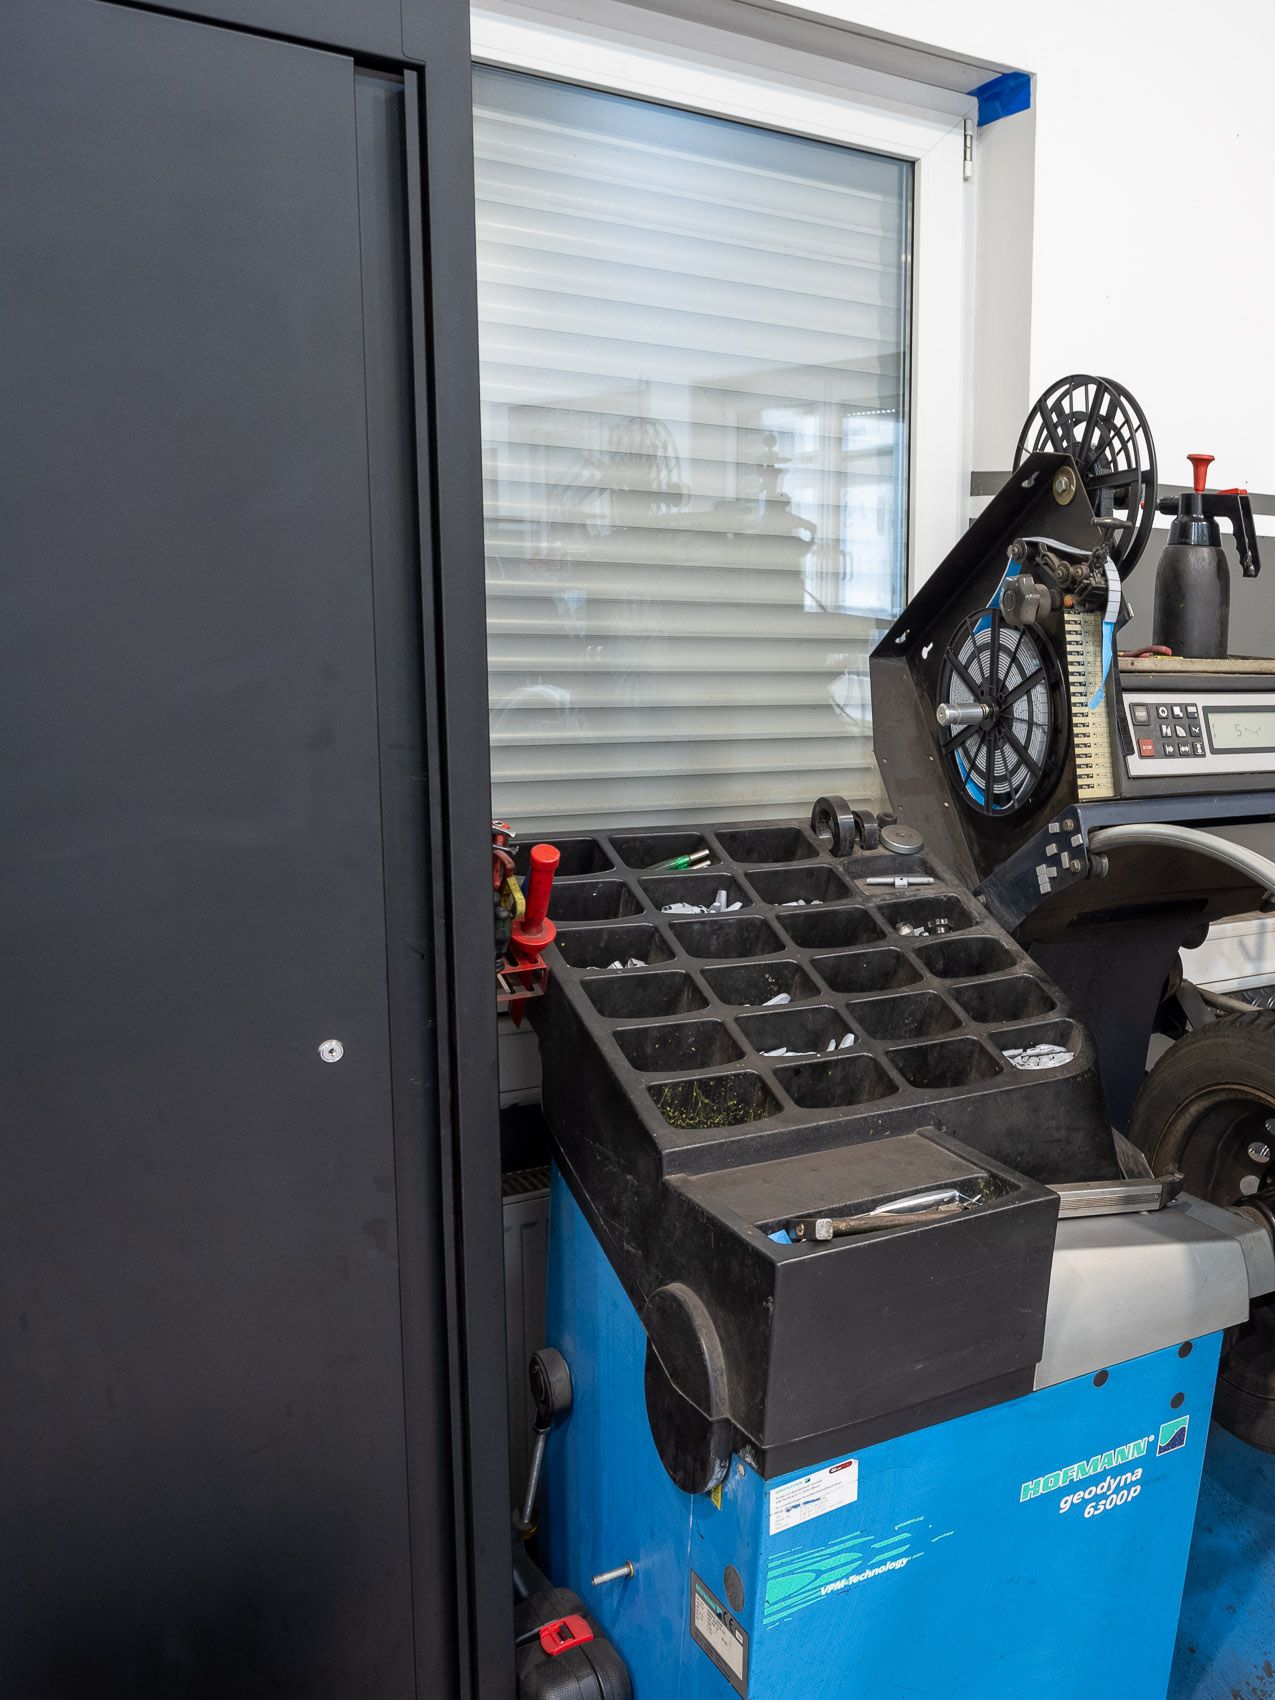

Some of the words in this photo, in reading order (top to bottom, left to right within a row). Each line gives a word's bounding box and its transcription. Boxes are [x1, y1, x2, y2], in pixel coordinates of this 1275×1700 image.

[1020, 1436, 1149, 1503] HOFMANN
[1059, 1467, 1143, 1514] geodyna
[820, 1557, 910, 1596] VPM-Technology
